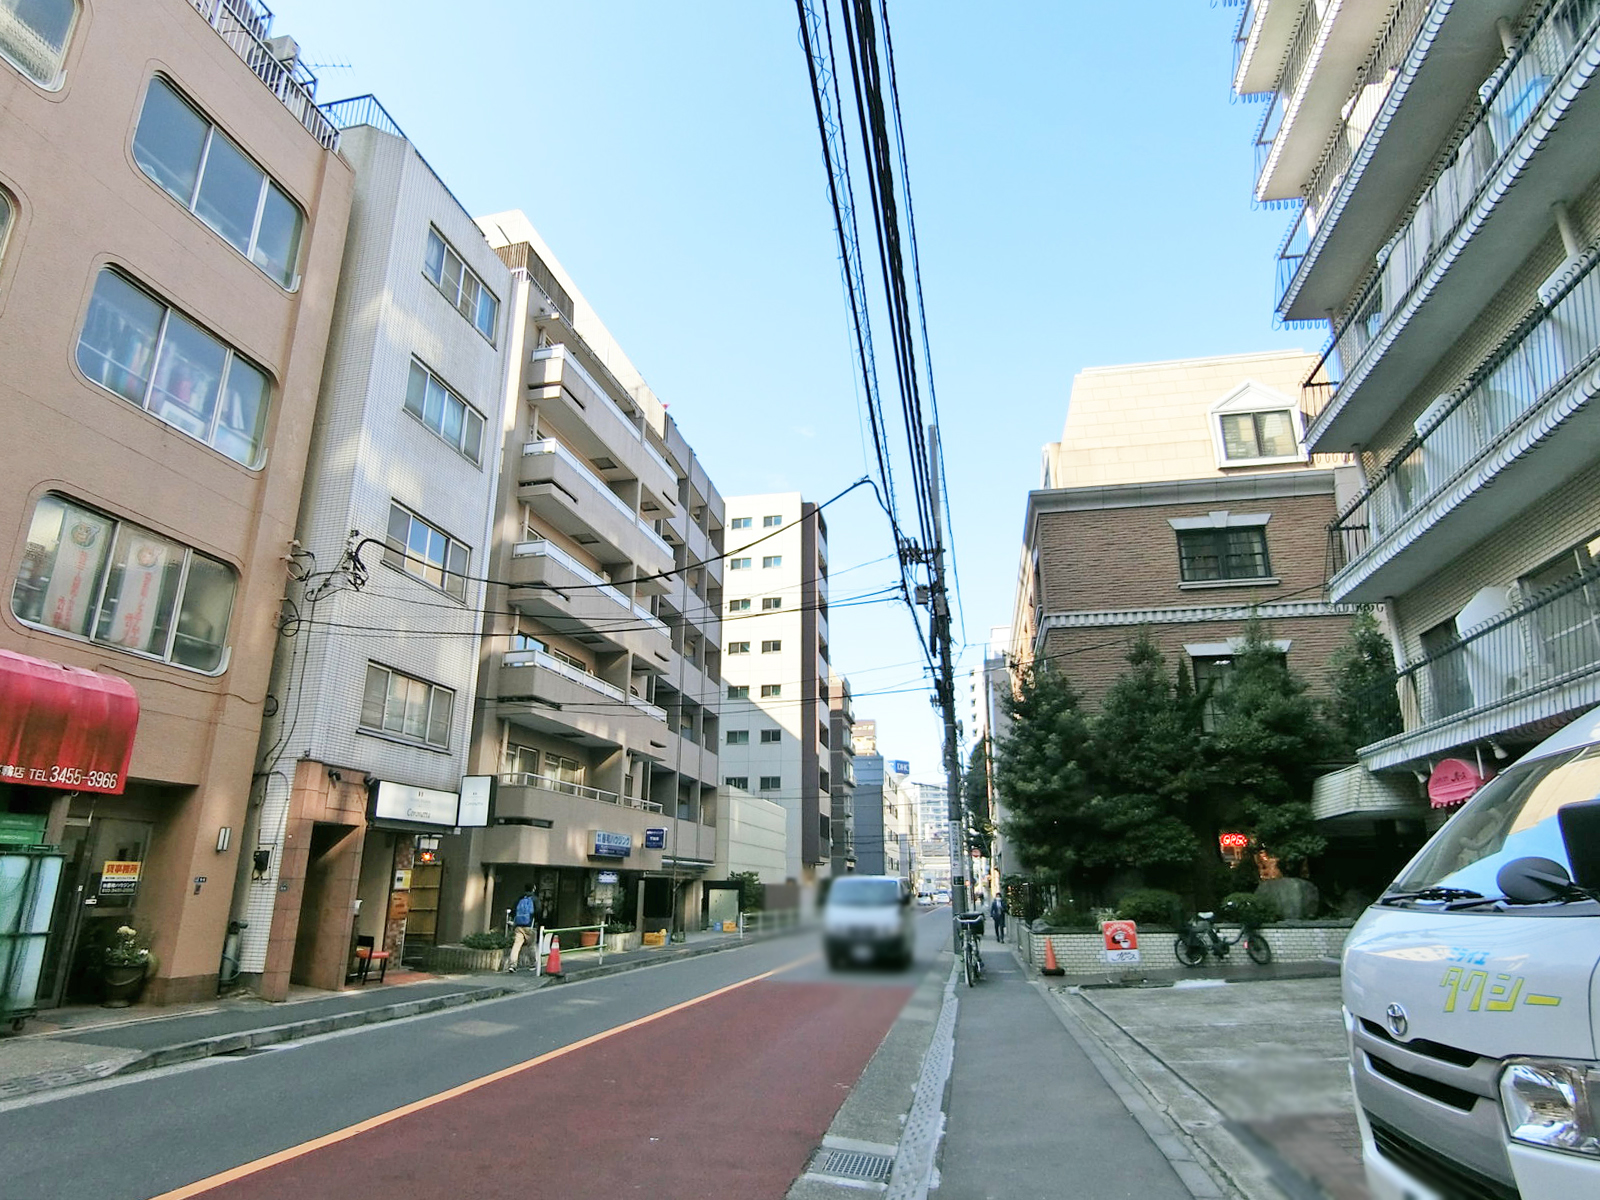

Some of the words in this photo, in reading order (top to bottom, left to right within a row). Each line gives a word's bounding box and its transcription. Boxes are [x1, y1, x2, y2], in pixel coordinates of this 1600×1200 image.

[29, 768, 48, 781] TEL
[49, 765, 118, 788] 3455-3966
[1447, 947, 1490, 966] ミライエ
[1439, 965, 1563, 1013] タクシー
